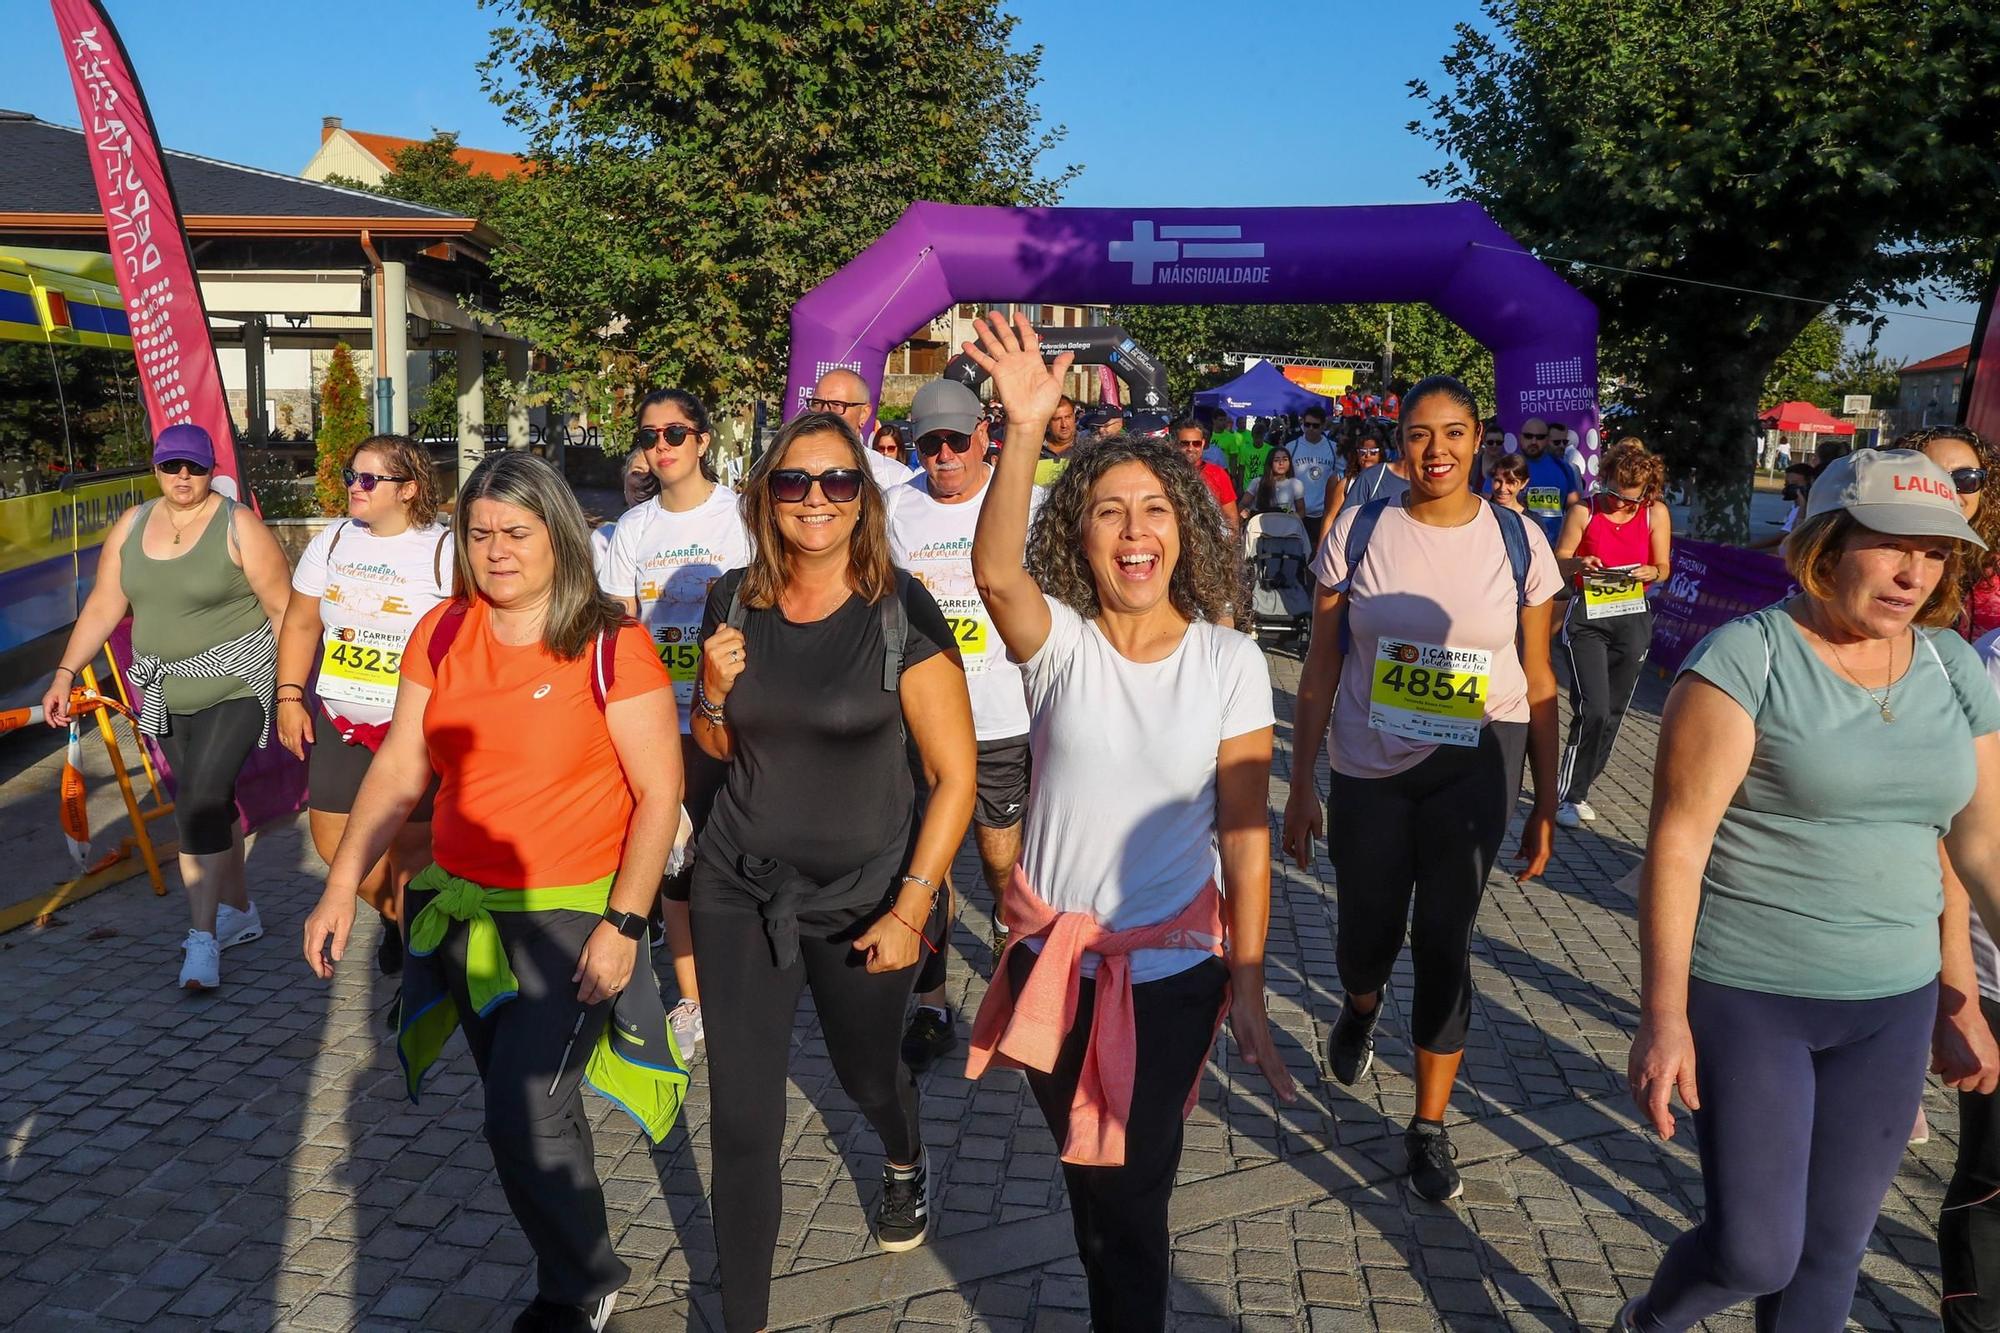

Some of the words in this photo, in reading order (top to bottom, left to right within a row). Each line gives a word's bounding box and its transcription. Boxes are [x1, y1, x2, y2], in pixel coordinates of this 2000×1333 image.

[1158, 264, 1271, 284] MÁISIGUALDADE
[1520, 384, 1594, 402] DEPUTACIÓN
[1520, 400, 1596, 413] PONTEVEDRA
[1530, 494, 1560, 505] 4406
[664, 547, 711, 559] CARREIRA
[933, 541, 973, 551] CARREIR
[355, 563, 396, 576] CARREIRA
[331, 644, 401, 675] 4323
[660, 645, 702, 669] 45
[1382, 665, 1480, 704] 4854
